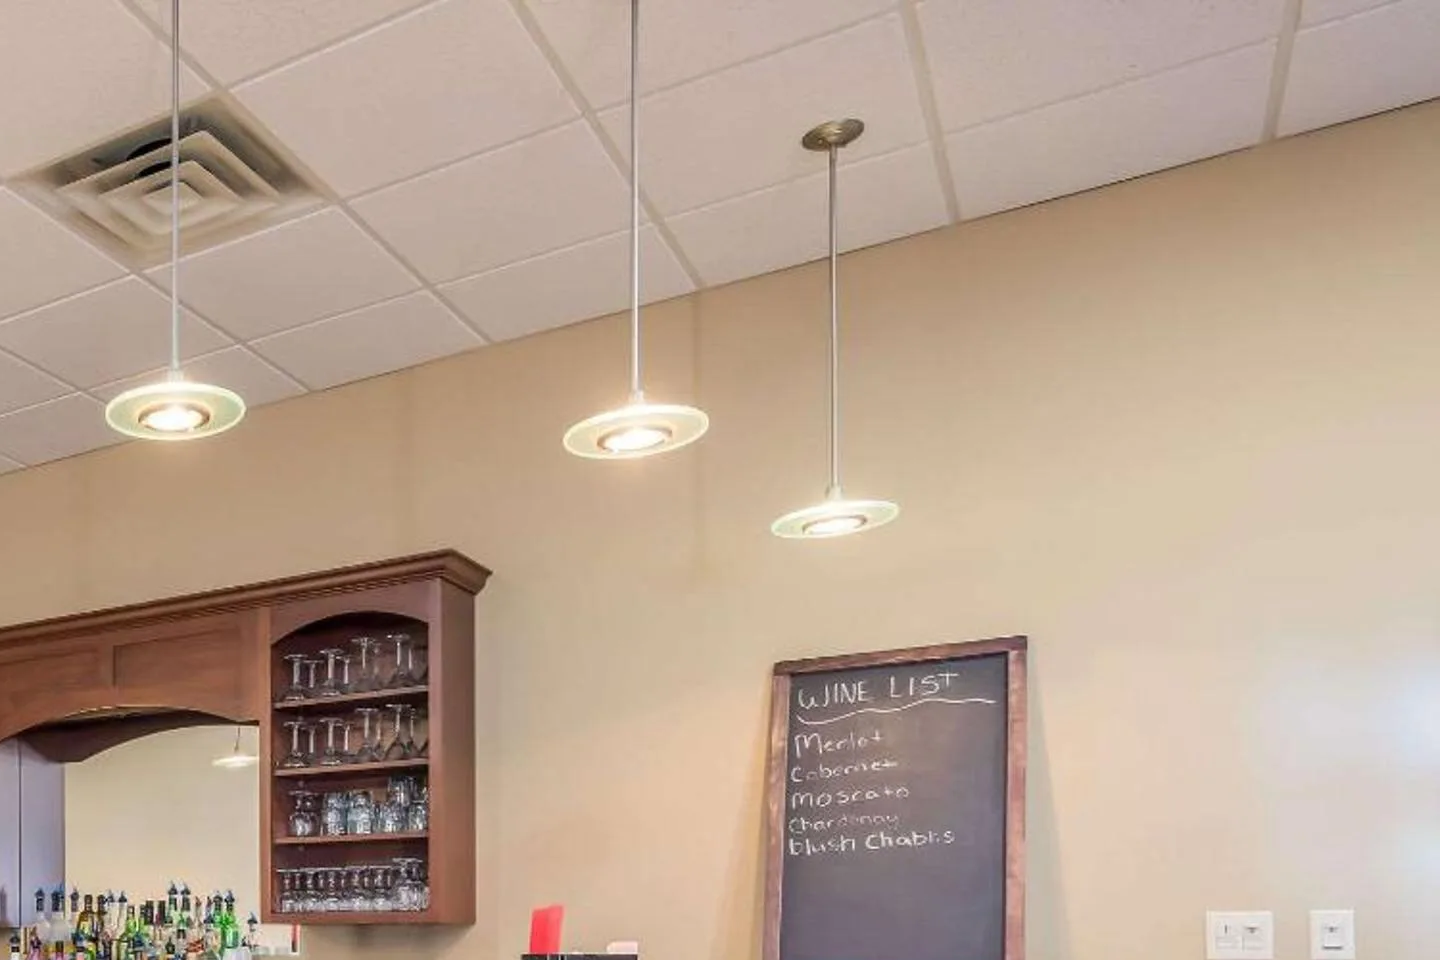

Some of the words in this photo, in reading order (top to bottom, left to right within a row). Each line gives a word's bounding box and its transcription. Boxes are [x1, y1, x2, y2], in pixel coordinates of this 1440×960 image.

[797, 680, 871, 710] WINE
[890, 672, 959, 698] LIST
[794, 729, 883, 759] Merlot
